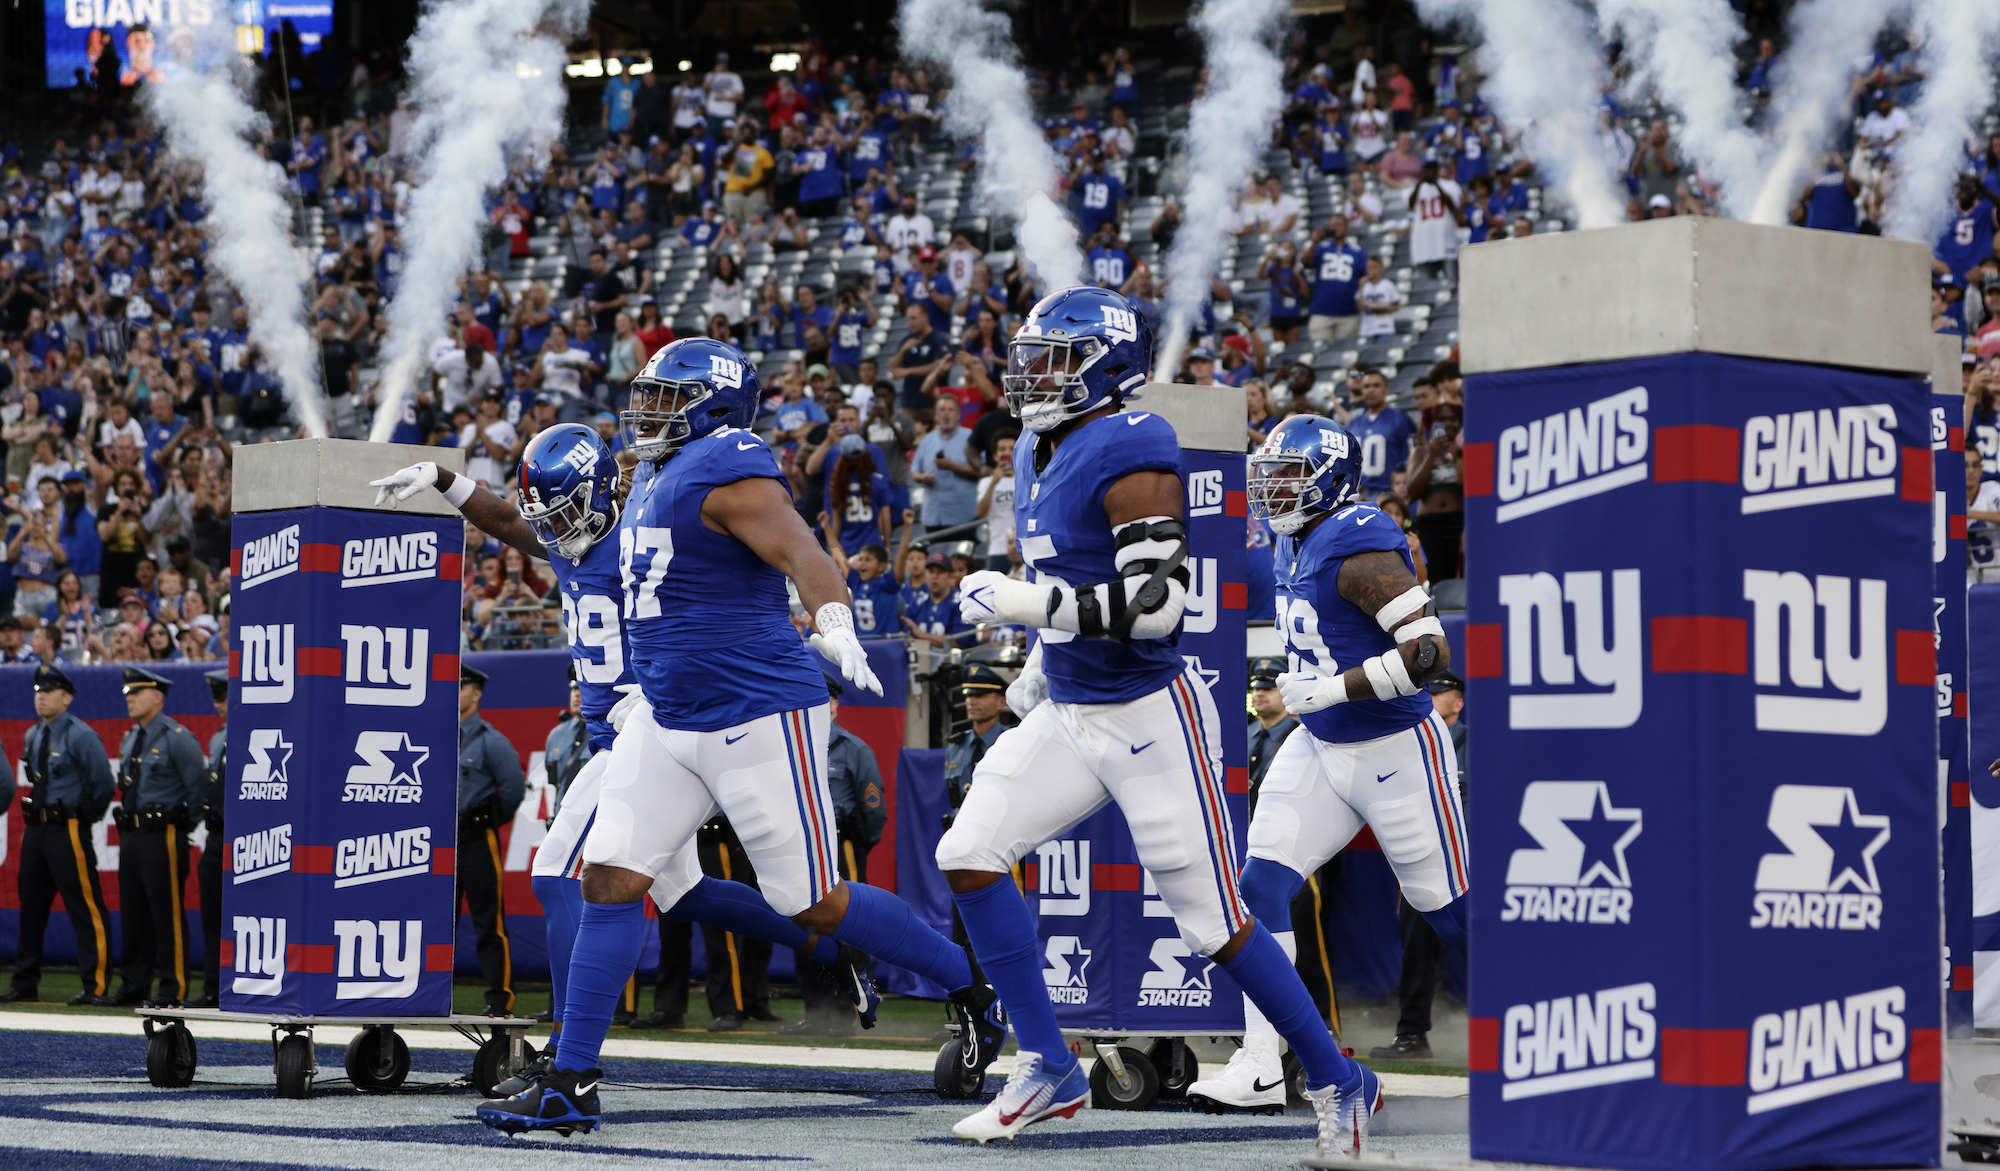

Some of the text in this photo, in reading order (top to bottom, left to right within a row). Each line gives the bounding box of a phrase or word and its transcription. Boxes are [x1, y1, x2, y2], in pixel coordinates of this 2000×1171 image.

[1464, 136, 1483, 160] 5
[1084, 183, 1109, 209] 19
[1418, 196, 1446, 221] 10
[1955, 218, 1973, 246] 5
[1319, 252, 1355, 282] 26
[1101, 304, 1137, 346] ny
[710, 355, 743, 390] ny
[563, 438, 600, 483] ny
[1319, 428, 1349, 459] ny
[1498, 386, 1649, 502] GIANTS
[1743, 403, 1898, 494] GIANTS
[846, 495, 874, 522] 26
[242, 524, 300, 580] GIANTS
[342, 531, 437, 578] GIANTS
[240, 624, 294, 704] ny
[341, 624, 429, 707] ny
[1499, 569, 1643, 729] ny
[1743, 569, 1888, 736] ny
[239, 782, 288, 800] STARTER
[342, 784, 423, 803] STARTER
[233, 823, 292, 874] GIANTS
[336, 826, 431, 878] GIANTS
[1036, 840, 1090, 916] ny
[1501, 886, 1633, 924] STARTER
[1750, 892, 1883, 930] STARTER
[232, 916, 286, 996] ny
[334, 920, 422, 999] ny
[1047, 986, 1088, 1004] TARTER
[1137, 989, 1212, 1007] STARTER
[1503, 982, 1657, 1080] GIANTS
[1749, 986, 1906, 1092] GIANTS
